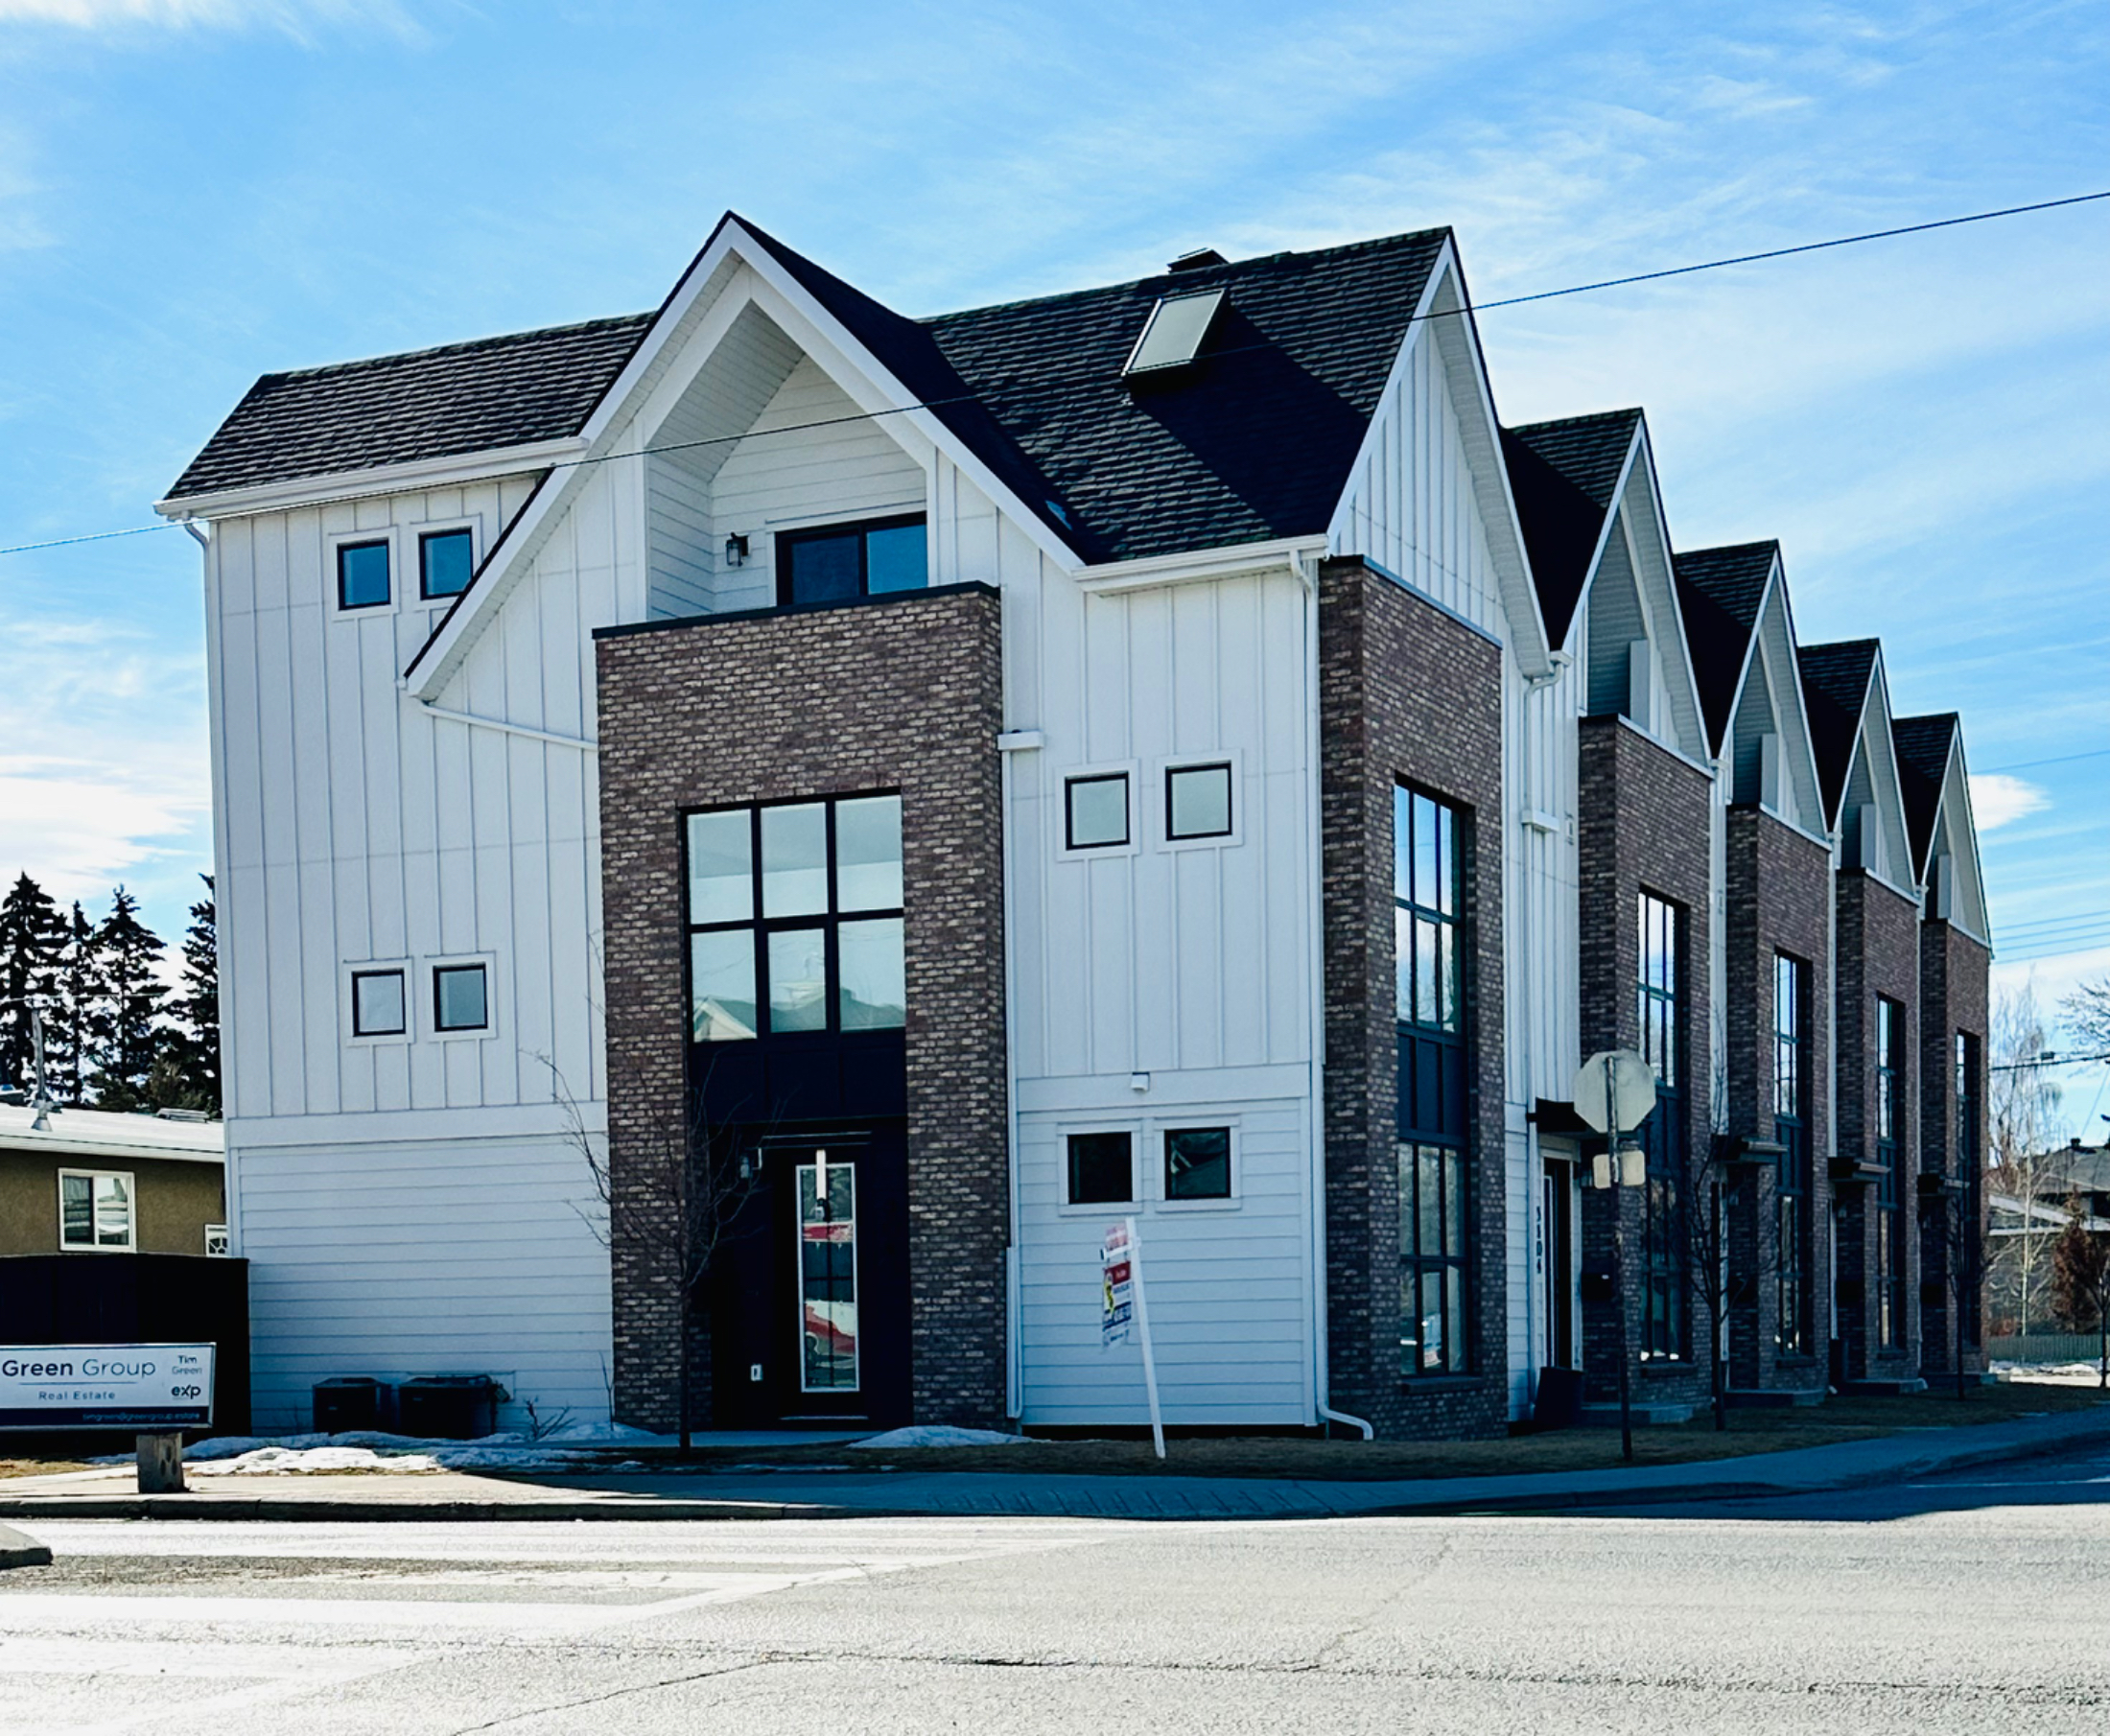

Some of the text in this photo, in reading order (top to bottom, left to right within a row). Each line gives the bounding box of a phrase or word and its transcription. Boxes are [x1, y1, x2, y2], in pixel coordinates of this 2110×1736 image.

[178, 1354, 198, 1364] Tim
[2, 1358, 156, 1378] Green Group
[38, 1390, 116, 1400] Real Estate
